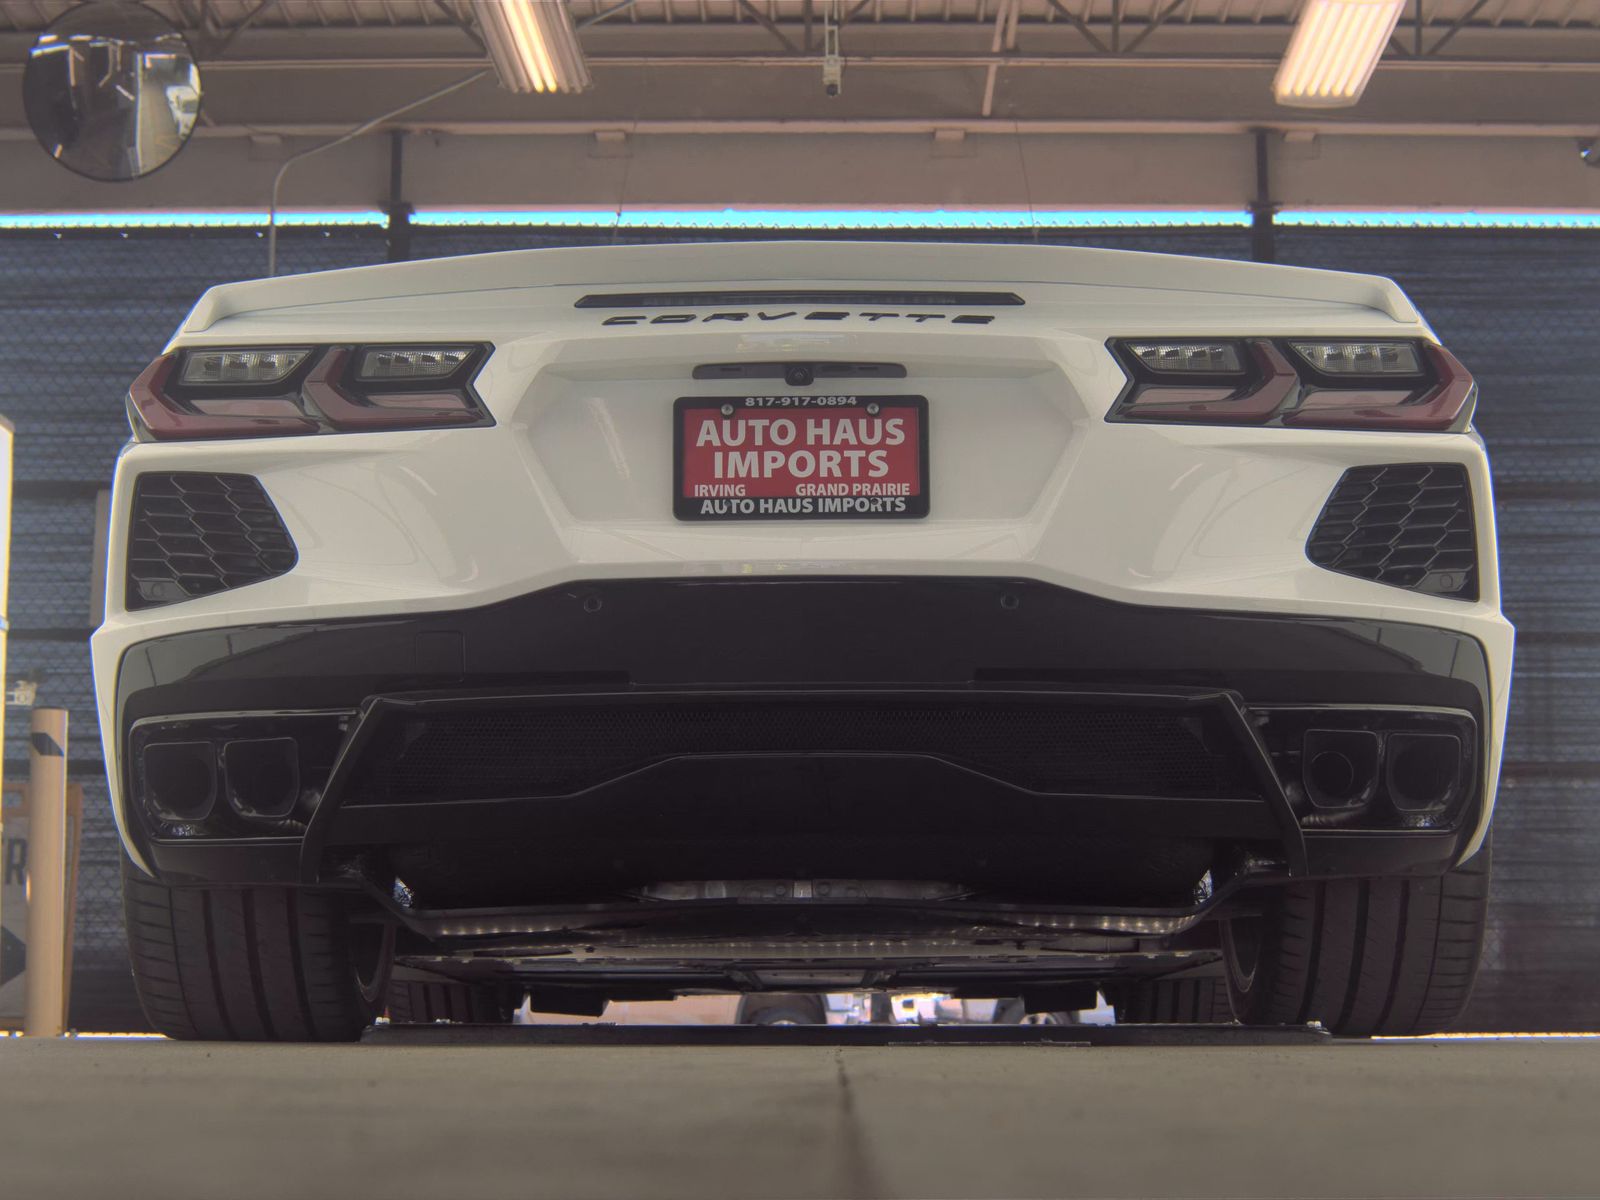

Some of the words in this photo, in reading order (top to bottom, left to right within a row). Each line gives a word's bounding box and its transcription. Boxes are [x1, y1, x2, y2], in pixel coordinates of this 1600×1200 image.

[601, 311, 996, 326] CORVETTE
[745, 396, 858, 406] 817-917-0894
[696, 419, 796, 447] AUTO
[806, 418, 905, 446] HAUS
[714, 449, 889, 478] IMPORTS
[694, 484, 746, 497] IRVING
[795, 483, 849, 496] GRAND
[853, 483, 910, 496] PRAIRIE
[700, 498, 755, 515] AUTO
[759, 498, 814, 514] HAUS
[818, 497, 906, 513] IMPORTS
